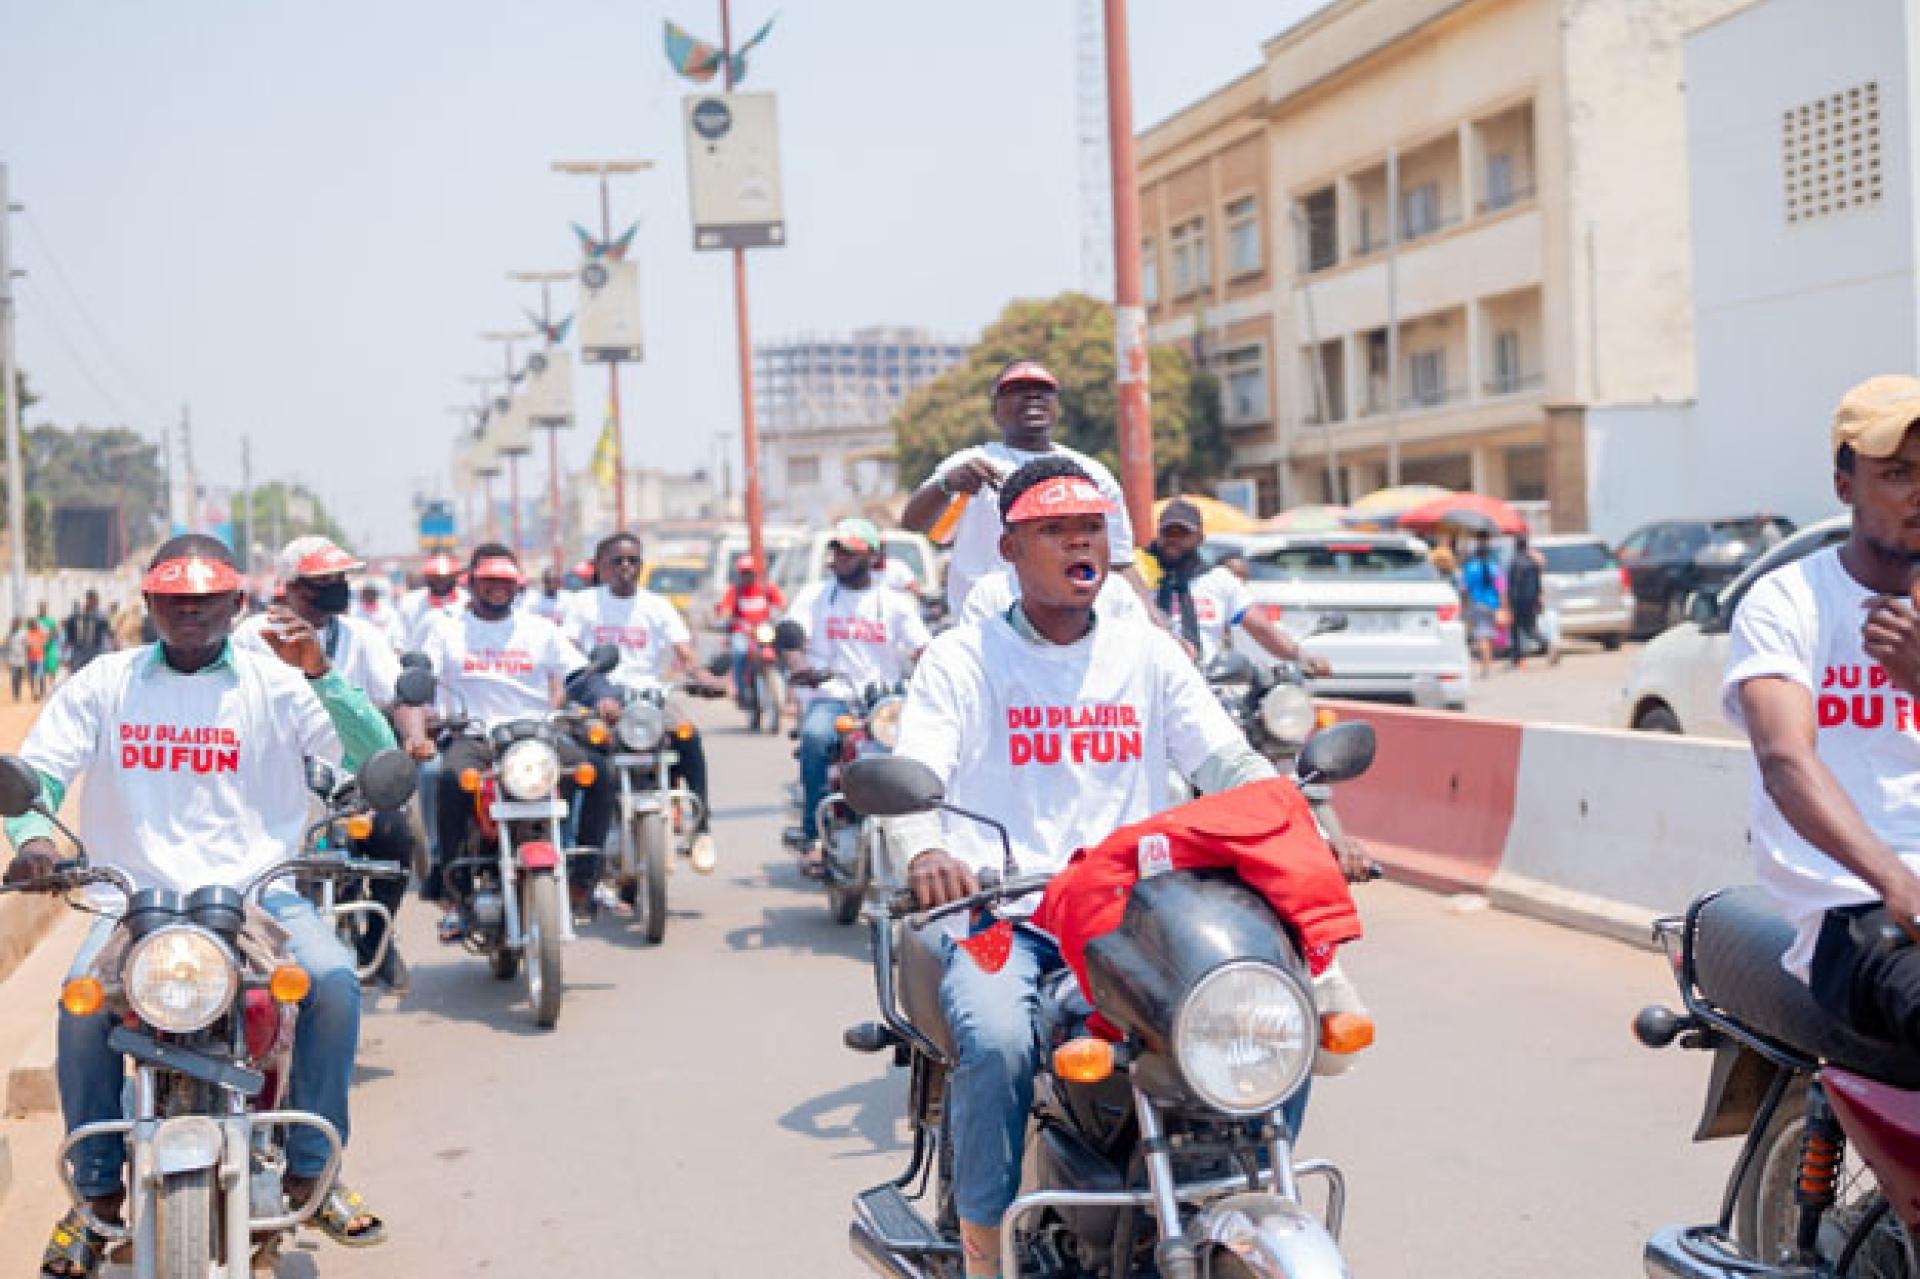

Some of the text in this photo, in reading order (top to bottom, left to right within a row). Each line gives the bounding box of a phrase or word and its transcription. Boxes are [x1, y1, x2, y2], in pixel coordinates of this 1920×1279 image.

[1008, 706, 1042, 729] DU
[1818, 694, 1920, 732] DU F
[119, 723, 151, 741] DU
[121, 745, 239, 775] DU FUN
[1010, 731, 1142, 766] DU FUN
